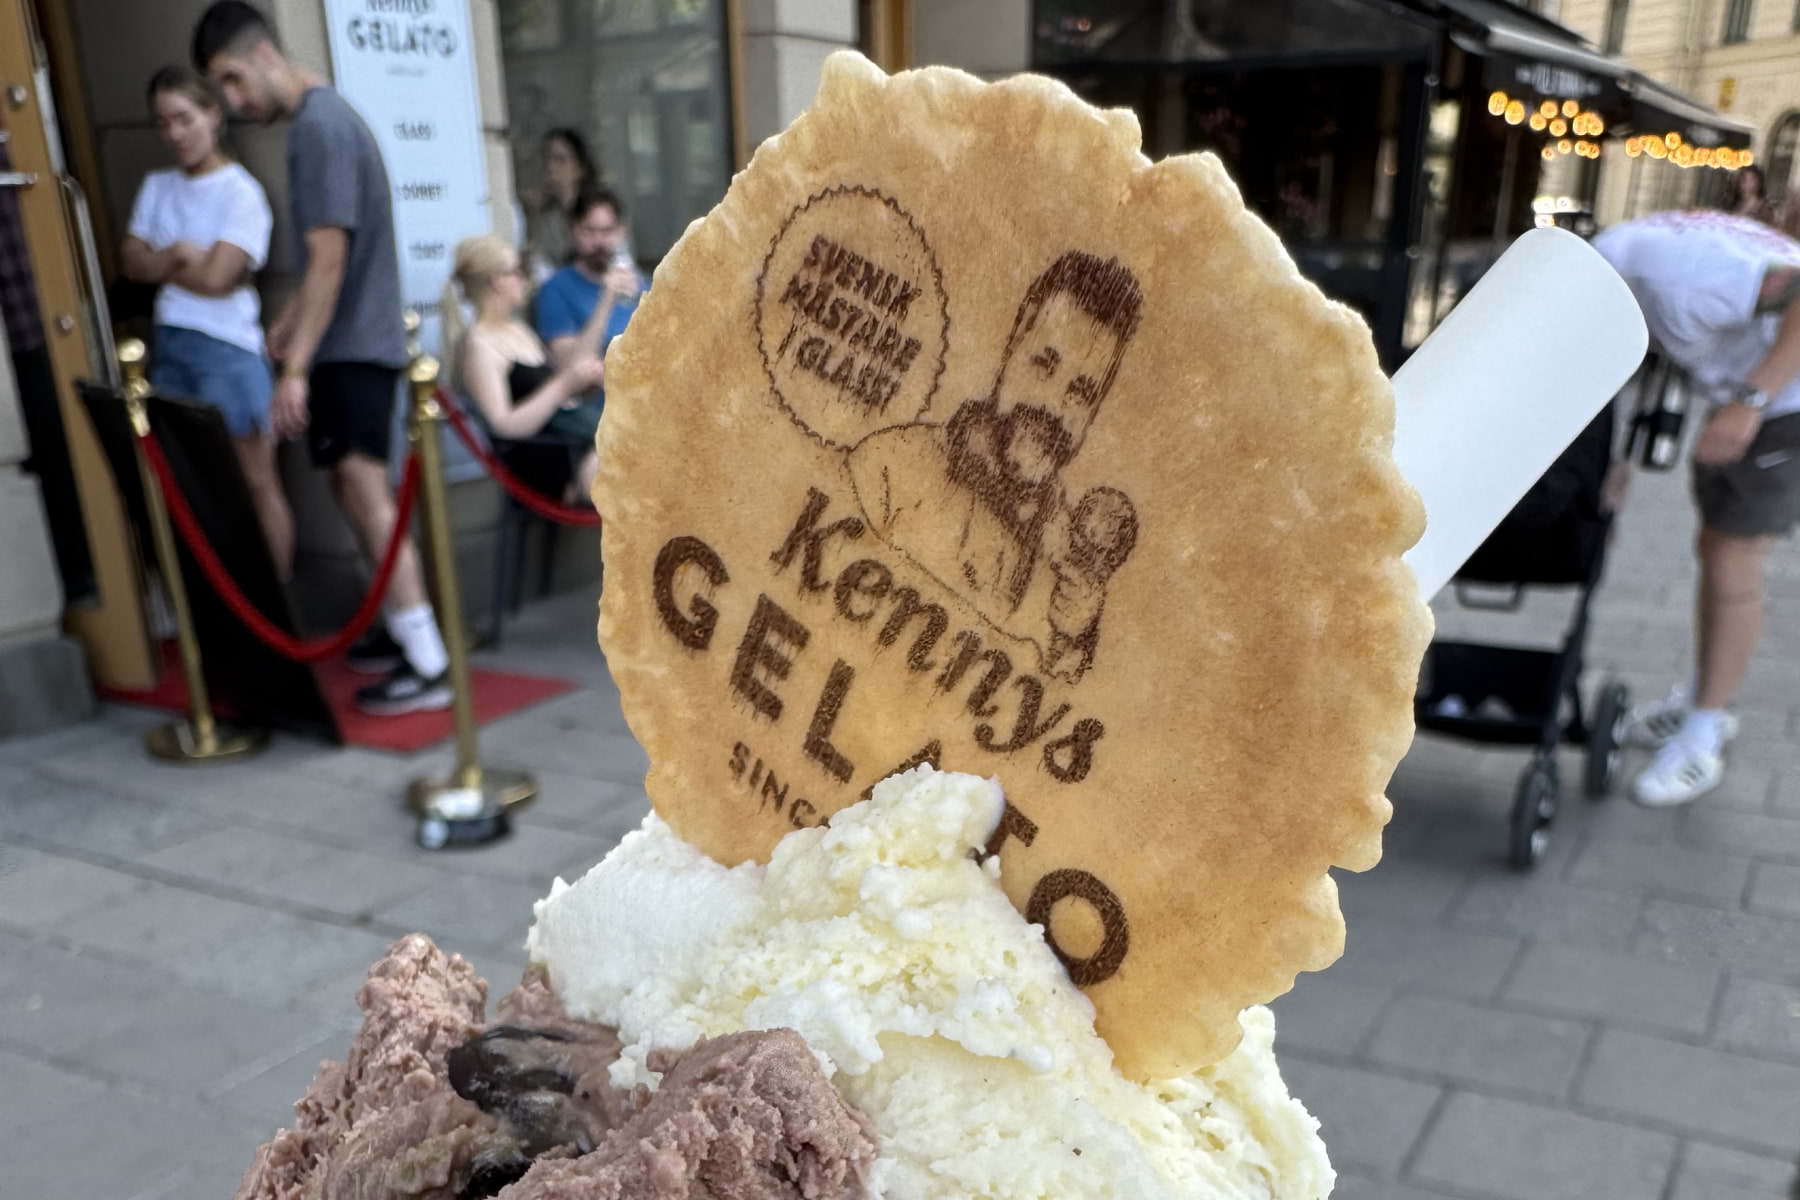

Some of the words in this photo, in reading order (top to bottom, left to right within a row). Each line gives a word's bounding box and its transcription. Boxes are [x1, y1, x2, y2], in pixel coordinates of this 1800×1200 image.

[347, 17, 457, 57] GELATO
[769, 486, 1105, 784] Kennys
[652, 535, 1129, 985] GELTO
[728, 741, 831, 829] SINC
